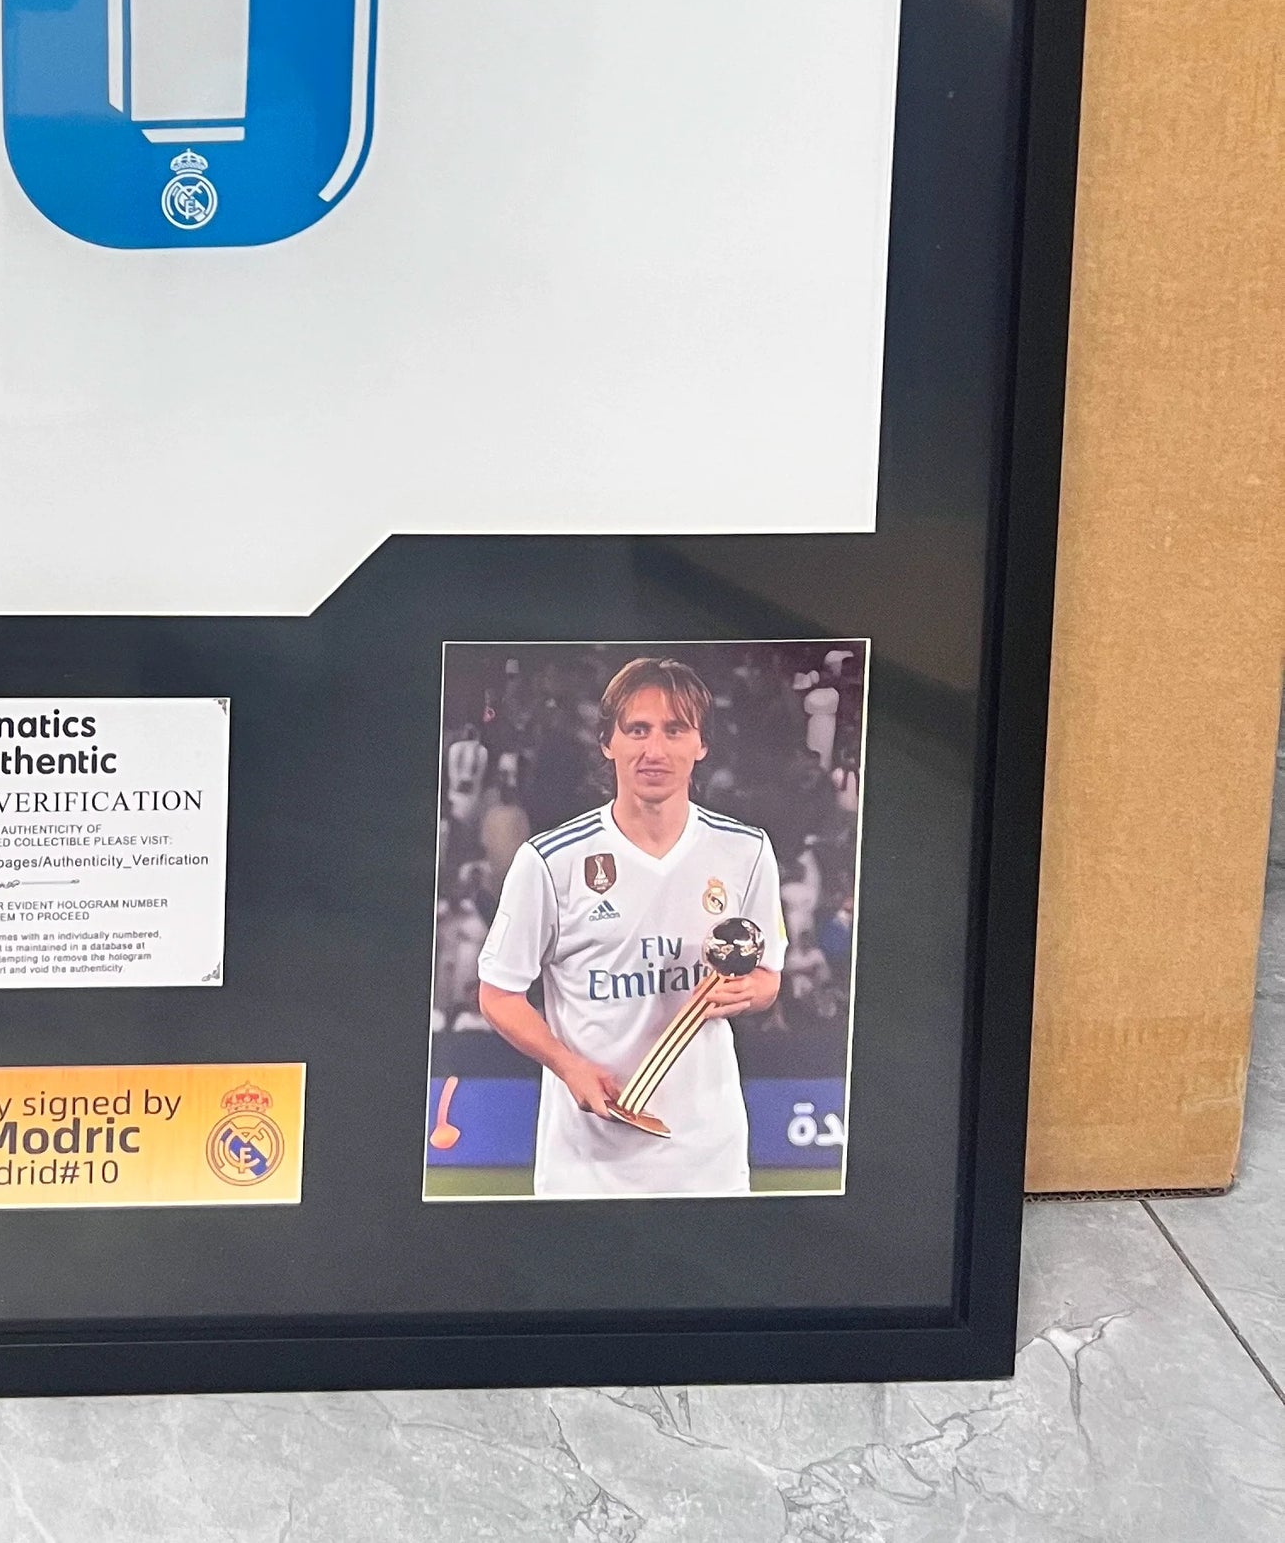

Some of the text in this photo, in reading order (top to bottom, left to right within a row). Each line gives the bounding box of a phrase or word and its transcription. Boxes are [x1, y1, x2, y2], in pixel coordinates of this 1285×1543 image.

[0, 824, 83, 835] AUTHENTICITY
[86, 823, 102, 833] OF
[14, 836, 90, 847] COLLECTIBLE
[94, 835, 137, 846] PLEASE
[7, 900, 54, 910] EVIDENT
[57, 899, 118, 909] HOLOGRAM
[122, 898, 167, 908] NUMBER
[19, 912, 33, 921] TO
[37, 911, 89, 921] PROCEED
[20, 933, 39, 941] with
[57, 931, 109, 941] individually
[5, 944, 12, 952] is
[16, 943, 67, 952] maintained
[90, 942, 132, 951] database
[136, 941, 145, 949] at
[640, 935, 682, 960] Fly
[41, 954, 50, 962] to
[53, 954, 87, 962] remove
[90, 953, 105, 962] the
[108, 952, 151, 963] hologram
[9, 965, 26, 973] and
[29, 965, 48, 973] void
[51, 965, 66, 973] the
[588, 960, 712, 1001] Emirat
[23, 1090, 131, 1121] signed
[144, 1089, 182, 1120] by
